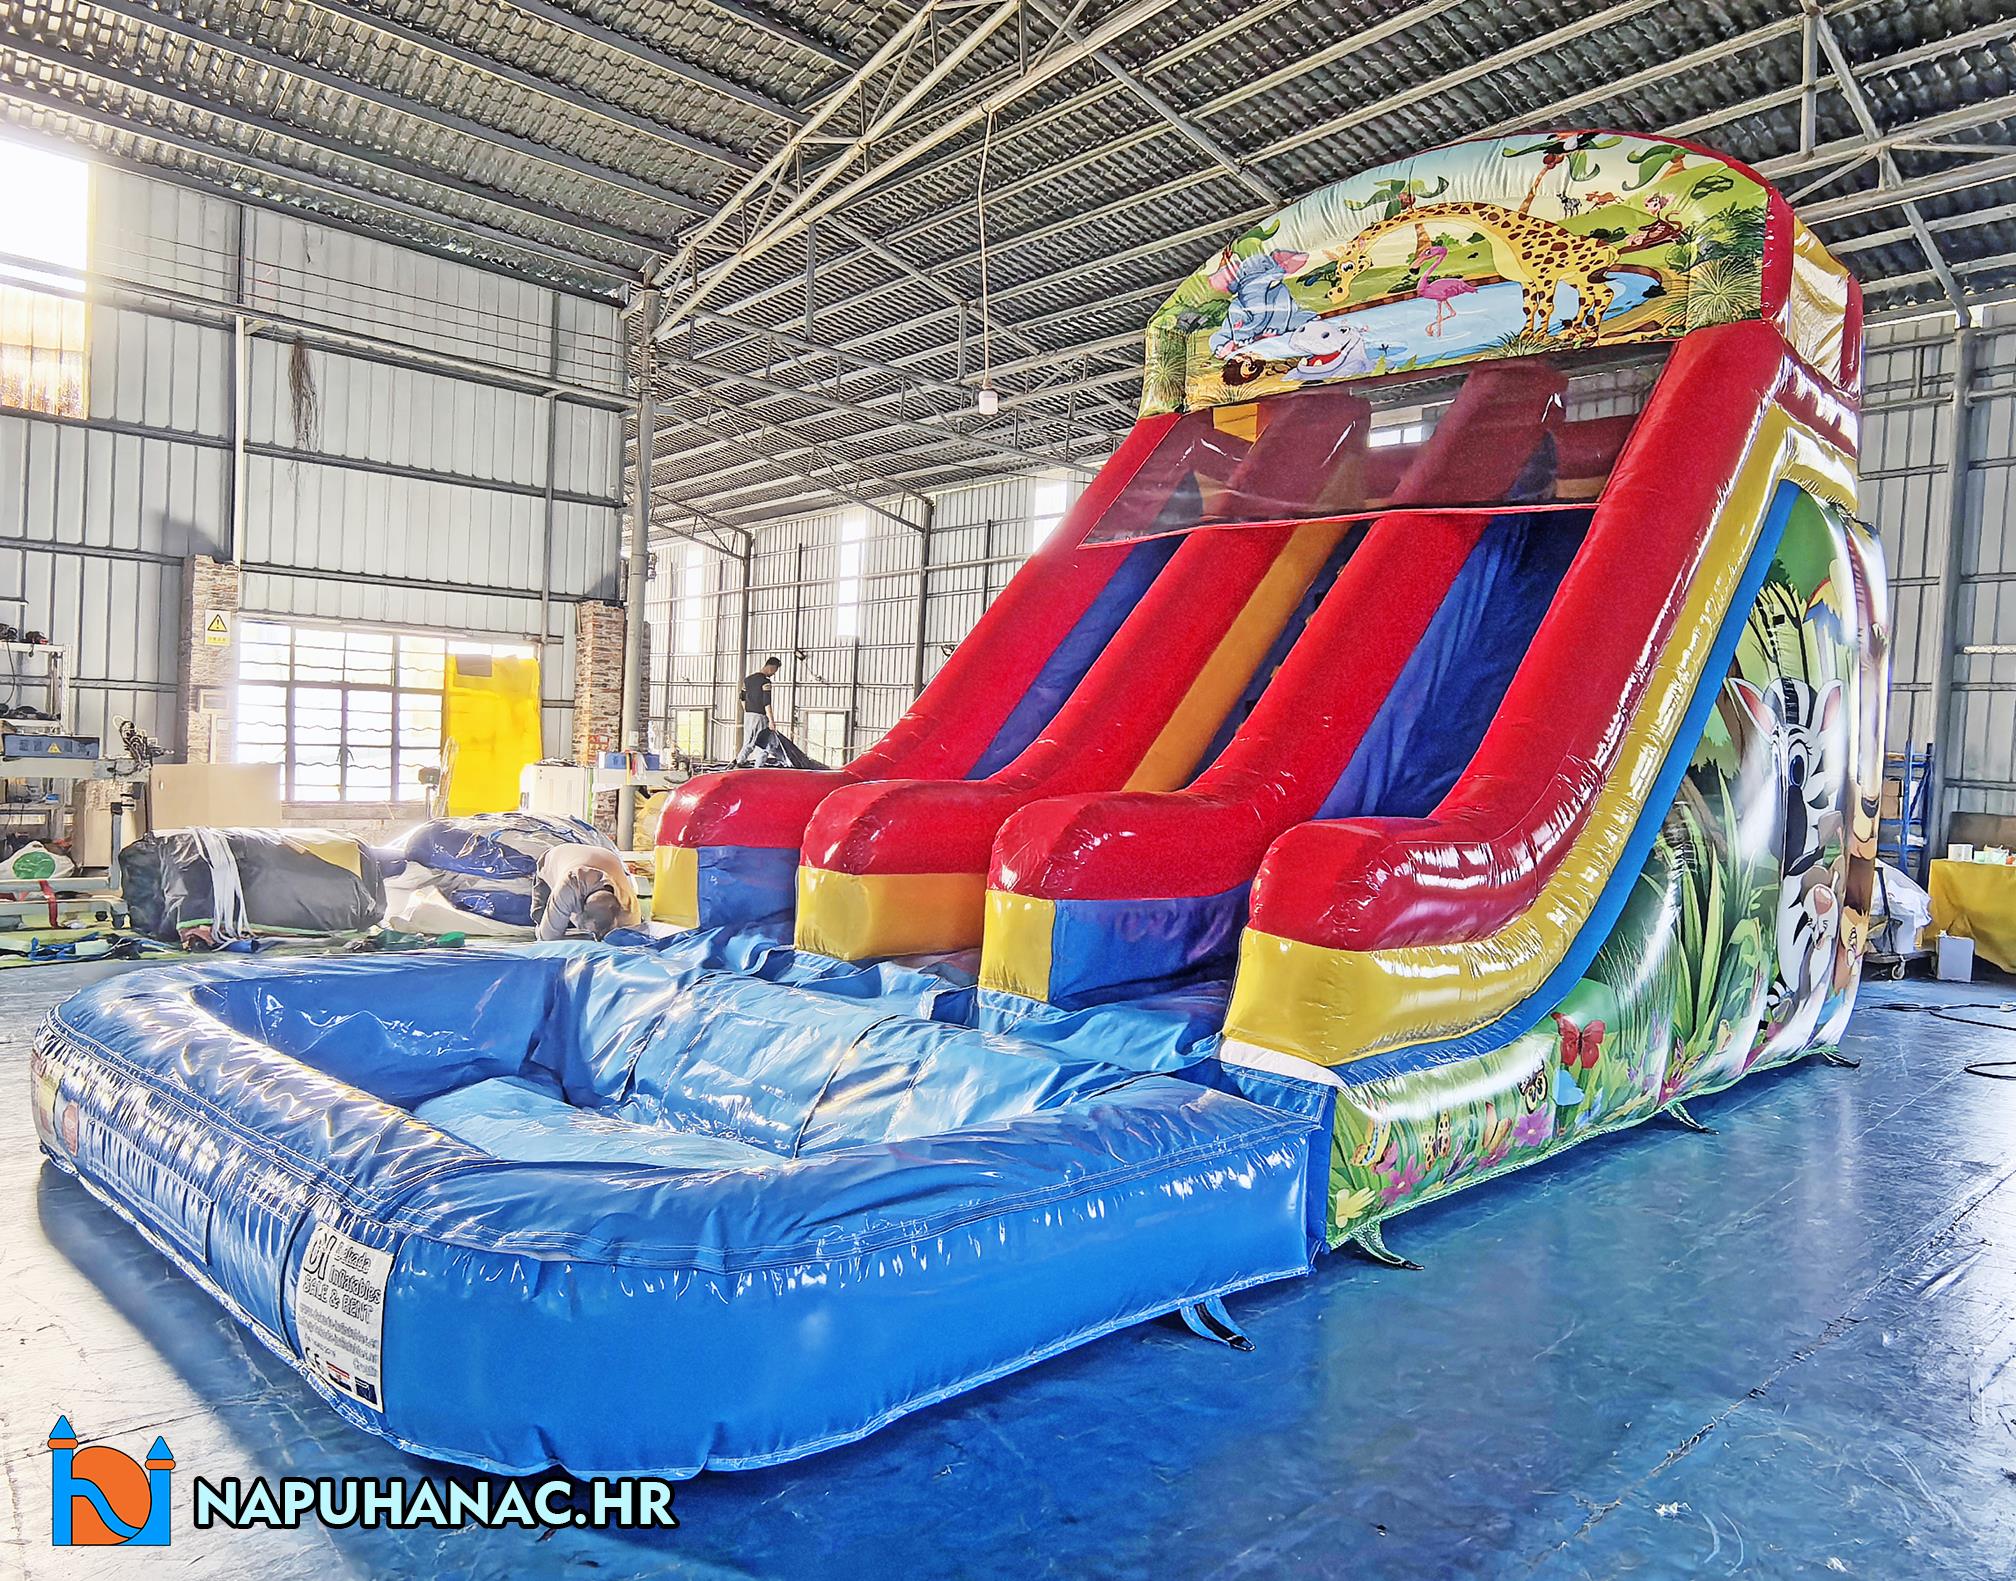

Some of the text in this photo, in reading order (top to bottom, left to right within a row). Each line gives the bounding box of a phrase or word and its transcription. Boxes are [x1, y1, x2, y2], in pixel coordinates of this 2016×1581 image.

[303, 1274, 374, 1324] SALE & RENT
